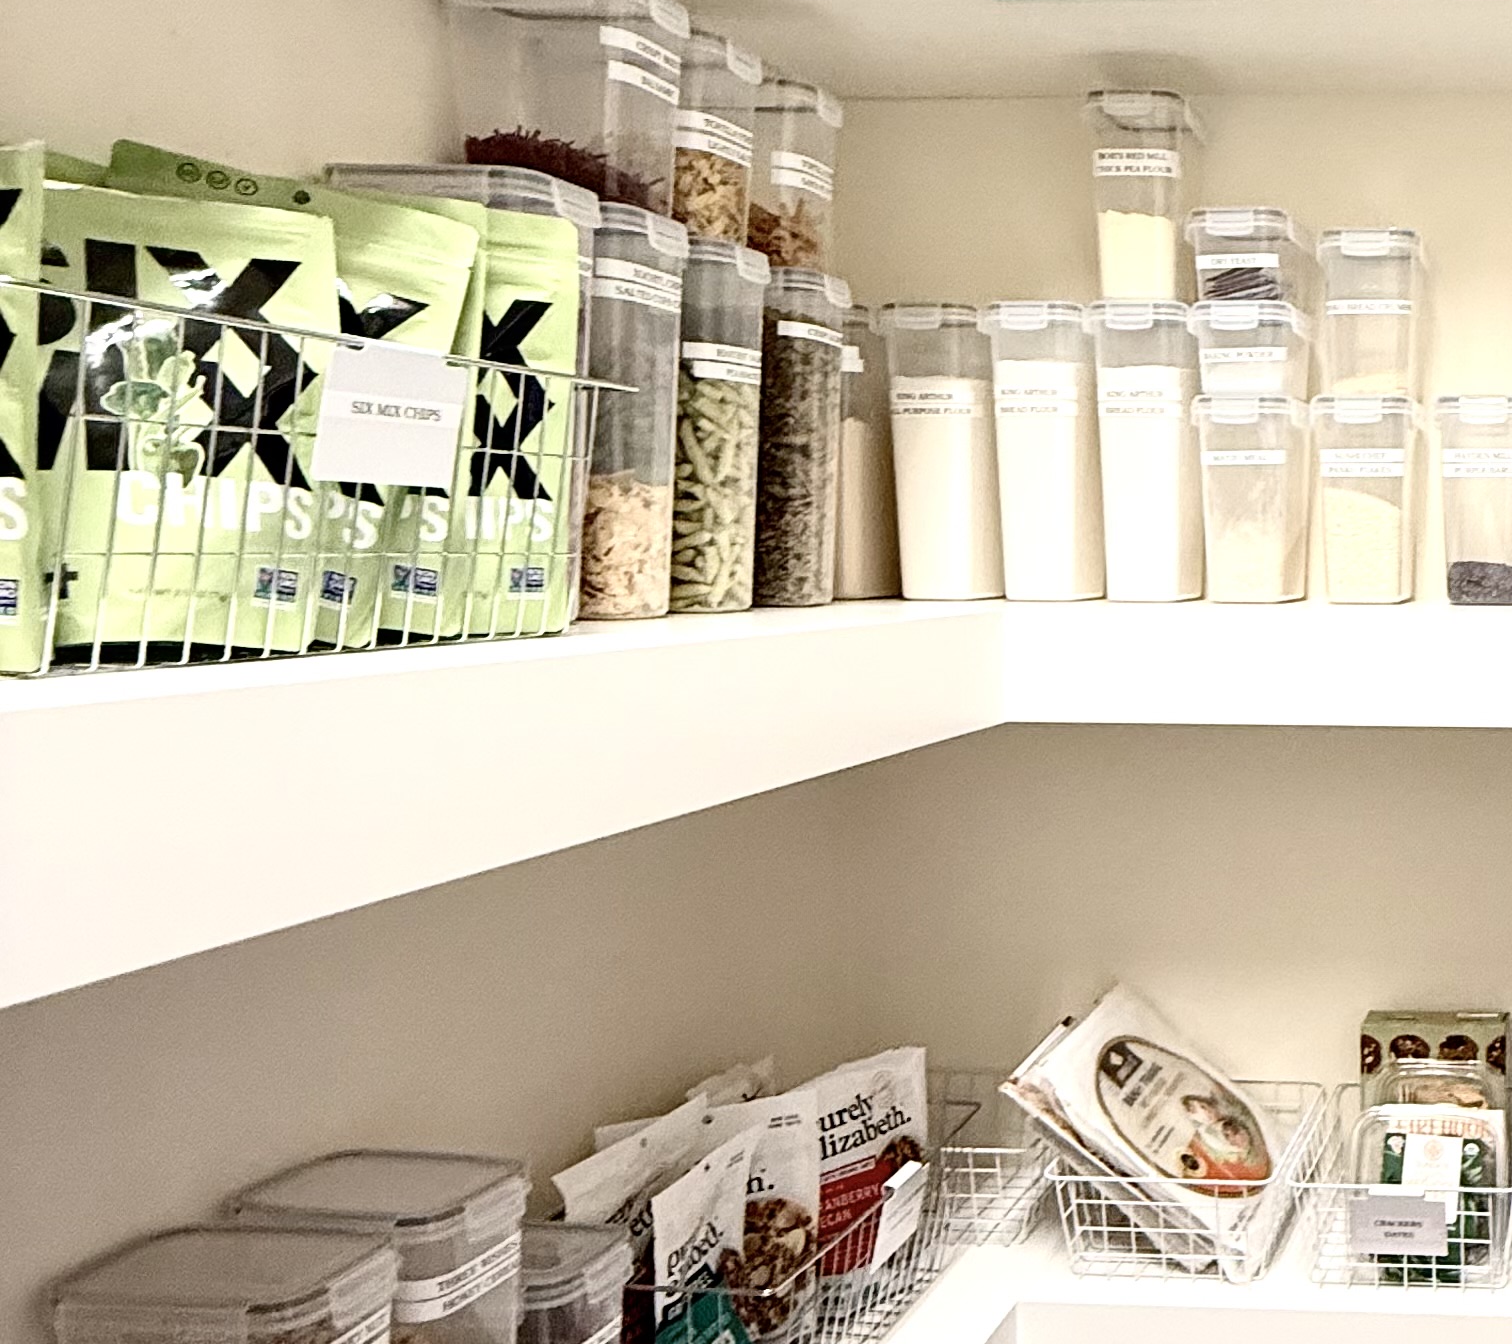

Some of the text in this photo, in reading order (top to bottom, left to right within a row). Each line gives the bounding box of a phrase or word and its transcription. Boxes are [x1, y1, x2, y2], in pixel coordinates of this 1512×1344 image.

[350, 401, 374, 415] SIX
[403, 406, 442, 422] CHIPS
[114, 469, 314, 544] CHIPS
[817, 1090, 876, 1134] urely
[819, 1107, 913, 1161] lizabeth.
[822, 1181, 881, 1213] ANBERRY
[820, 1208, 853, 1229] ECAN
